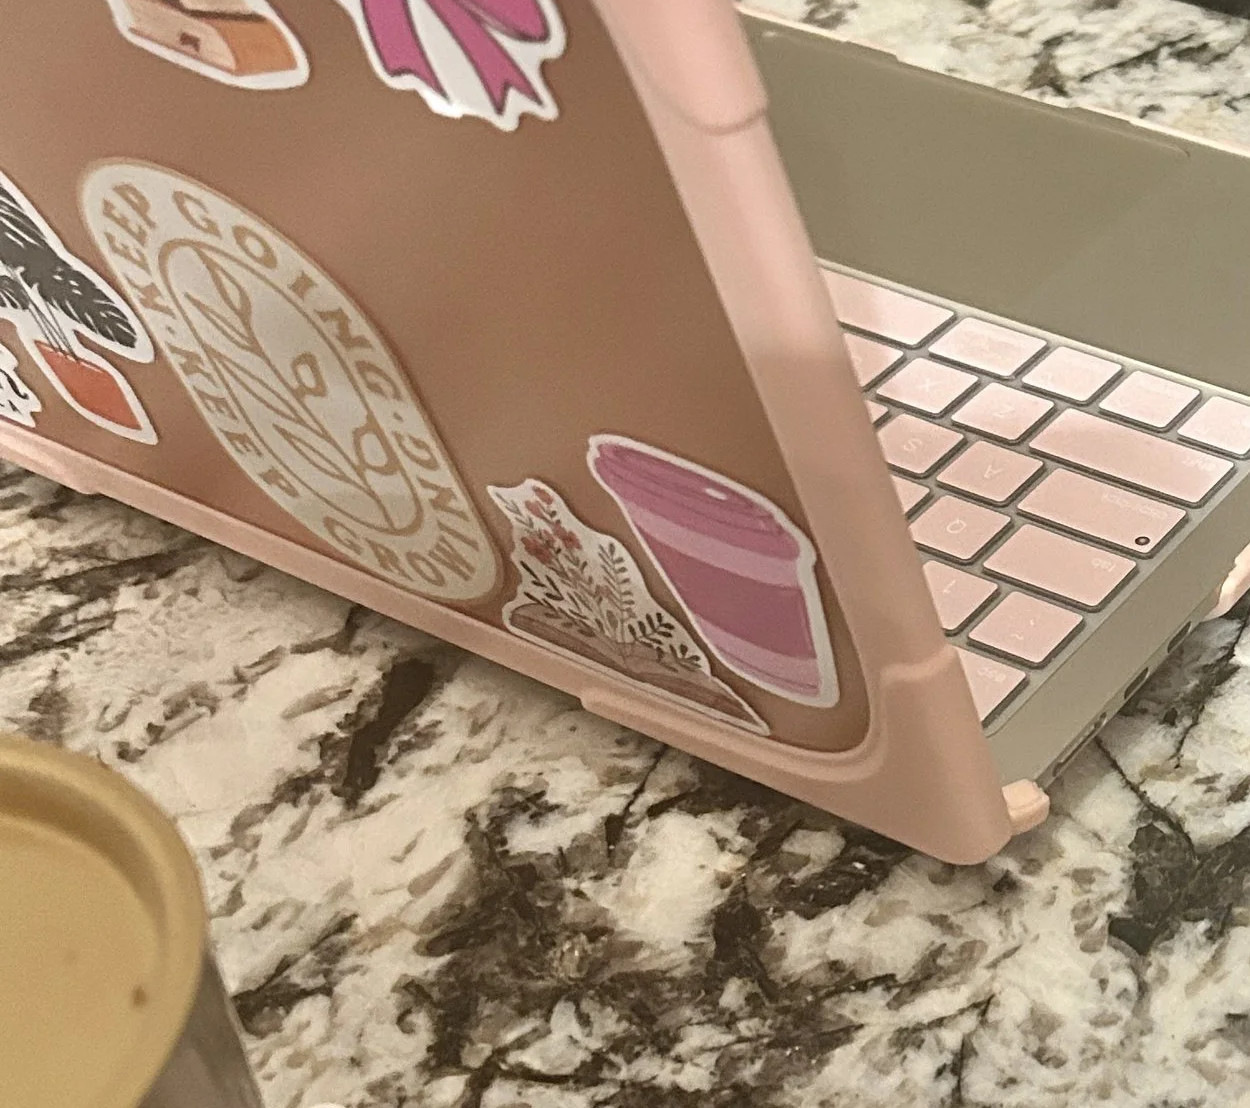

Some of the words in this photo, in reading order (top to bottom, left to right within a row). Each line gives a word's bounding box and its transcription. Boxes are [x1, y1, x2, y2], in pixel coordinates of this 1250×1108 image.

[102, 182, 178, 319] KEEP
[172, 189, 402, 401] GOING
[903, 437, 922, 452] S
[166, 342, 300, 499] KEEP
[322, 431, 480, 588] GROWING
[983, 464, 1004, 479] A
[946, 518, 967, 534] Q
